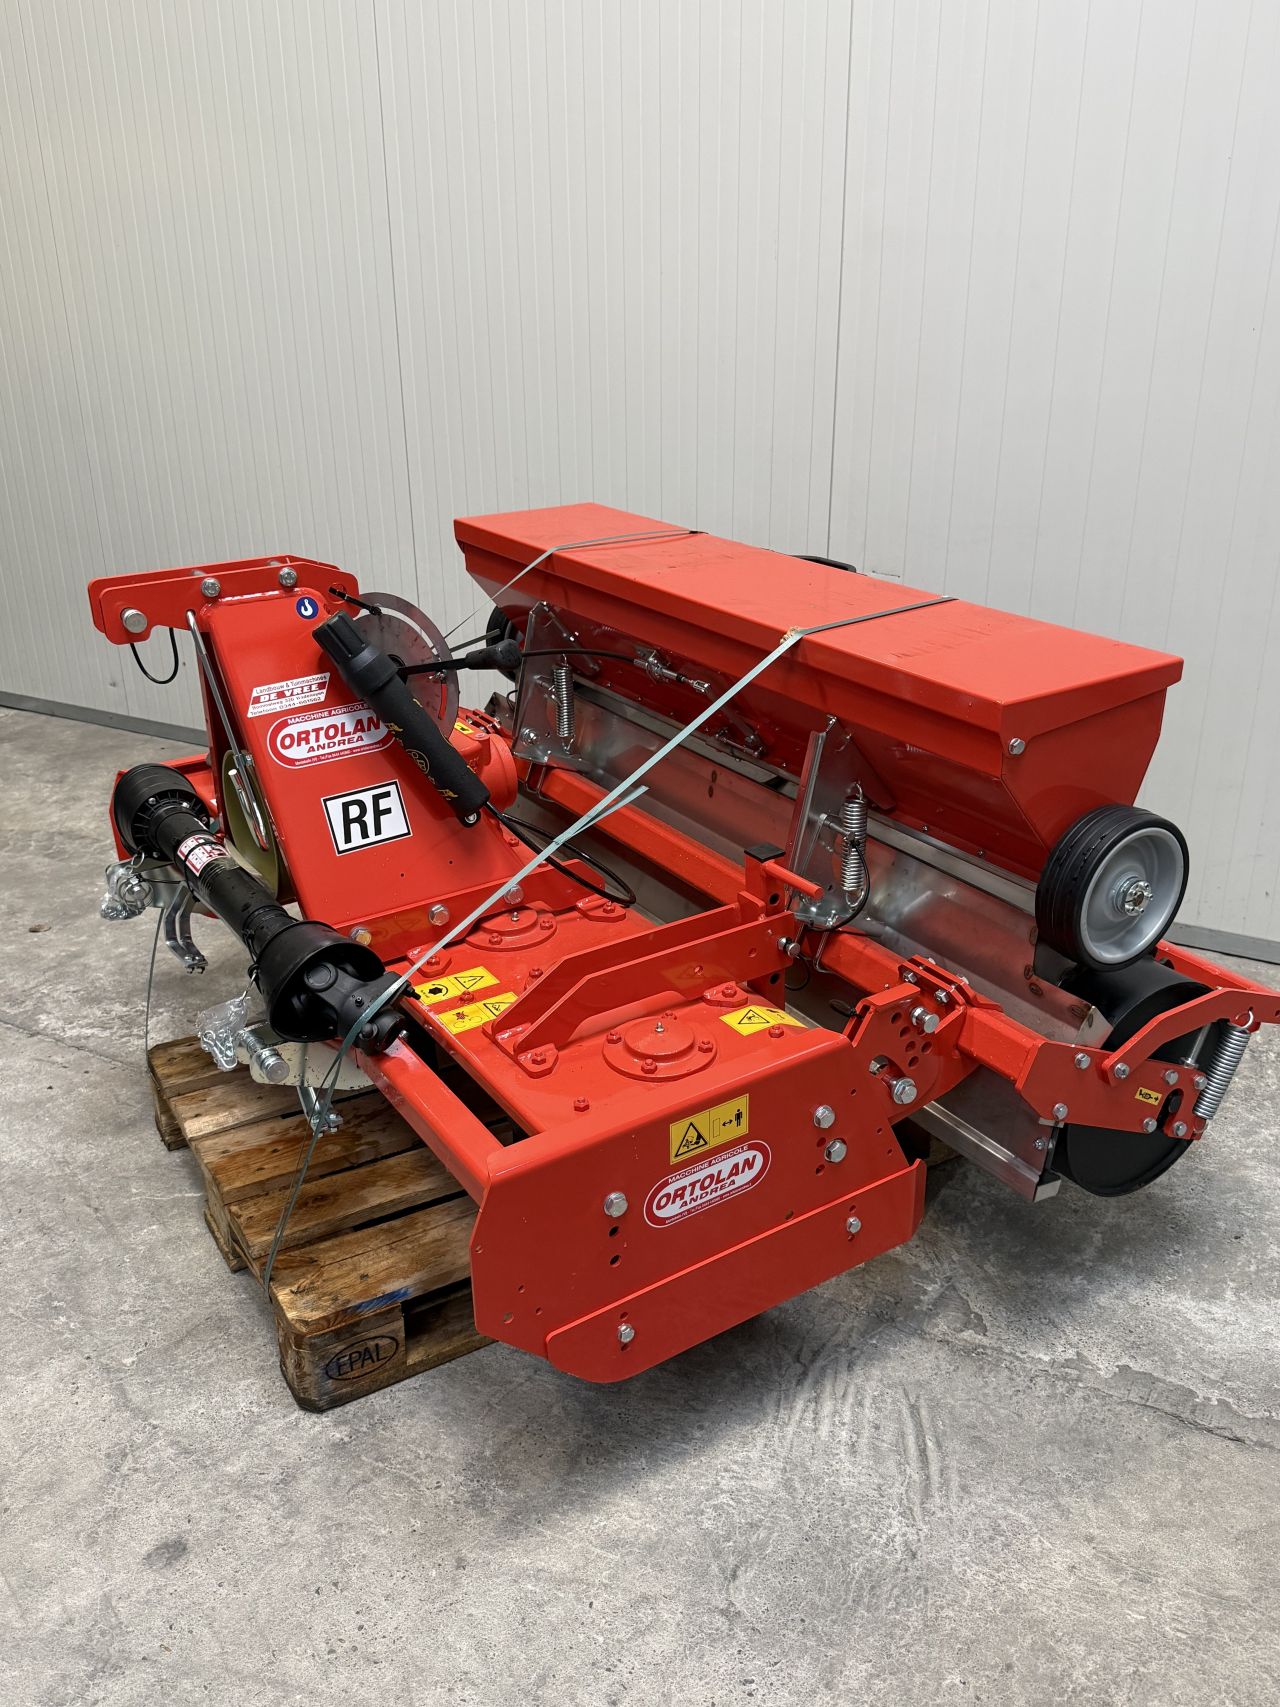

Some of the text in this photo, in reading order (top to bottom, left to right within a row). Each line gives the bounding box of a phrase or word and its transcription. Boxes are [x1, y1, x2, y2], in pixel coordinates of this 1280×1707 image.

[260, 693, 278, 702] DE
[284, 683, 319, 697] VREE
[280, 715, 381, 750] ORTOLAN
[287, 711, 330, 725] MACCHINE
[307, 735, 365, 753] ANDREA
[341, 790, 392, 844] RF
[668, 1144, 749, 1184] MACCHINE AGRICOLE
[655, 1154, 757, 1211] ORTOLAN
[679, 1179, 736, 1209] ANDREA
[337, 1343, 390, 1377] EPAL
